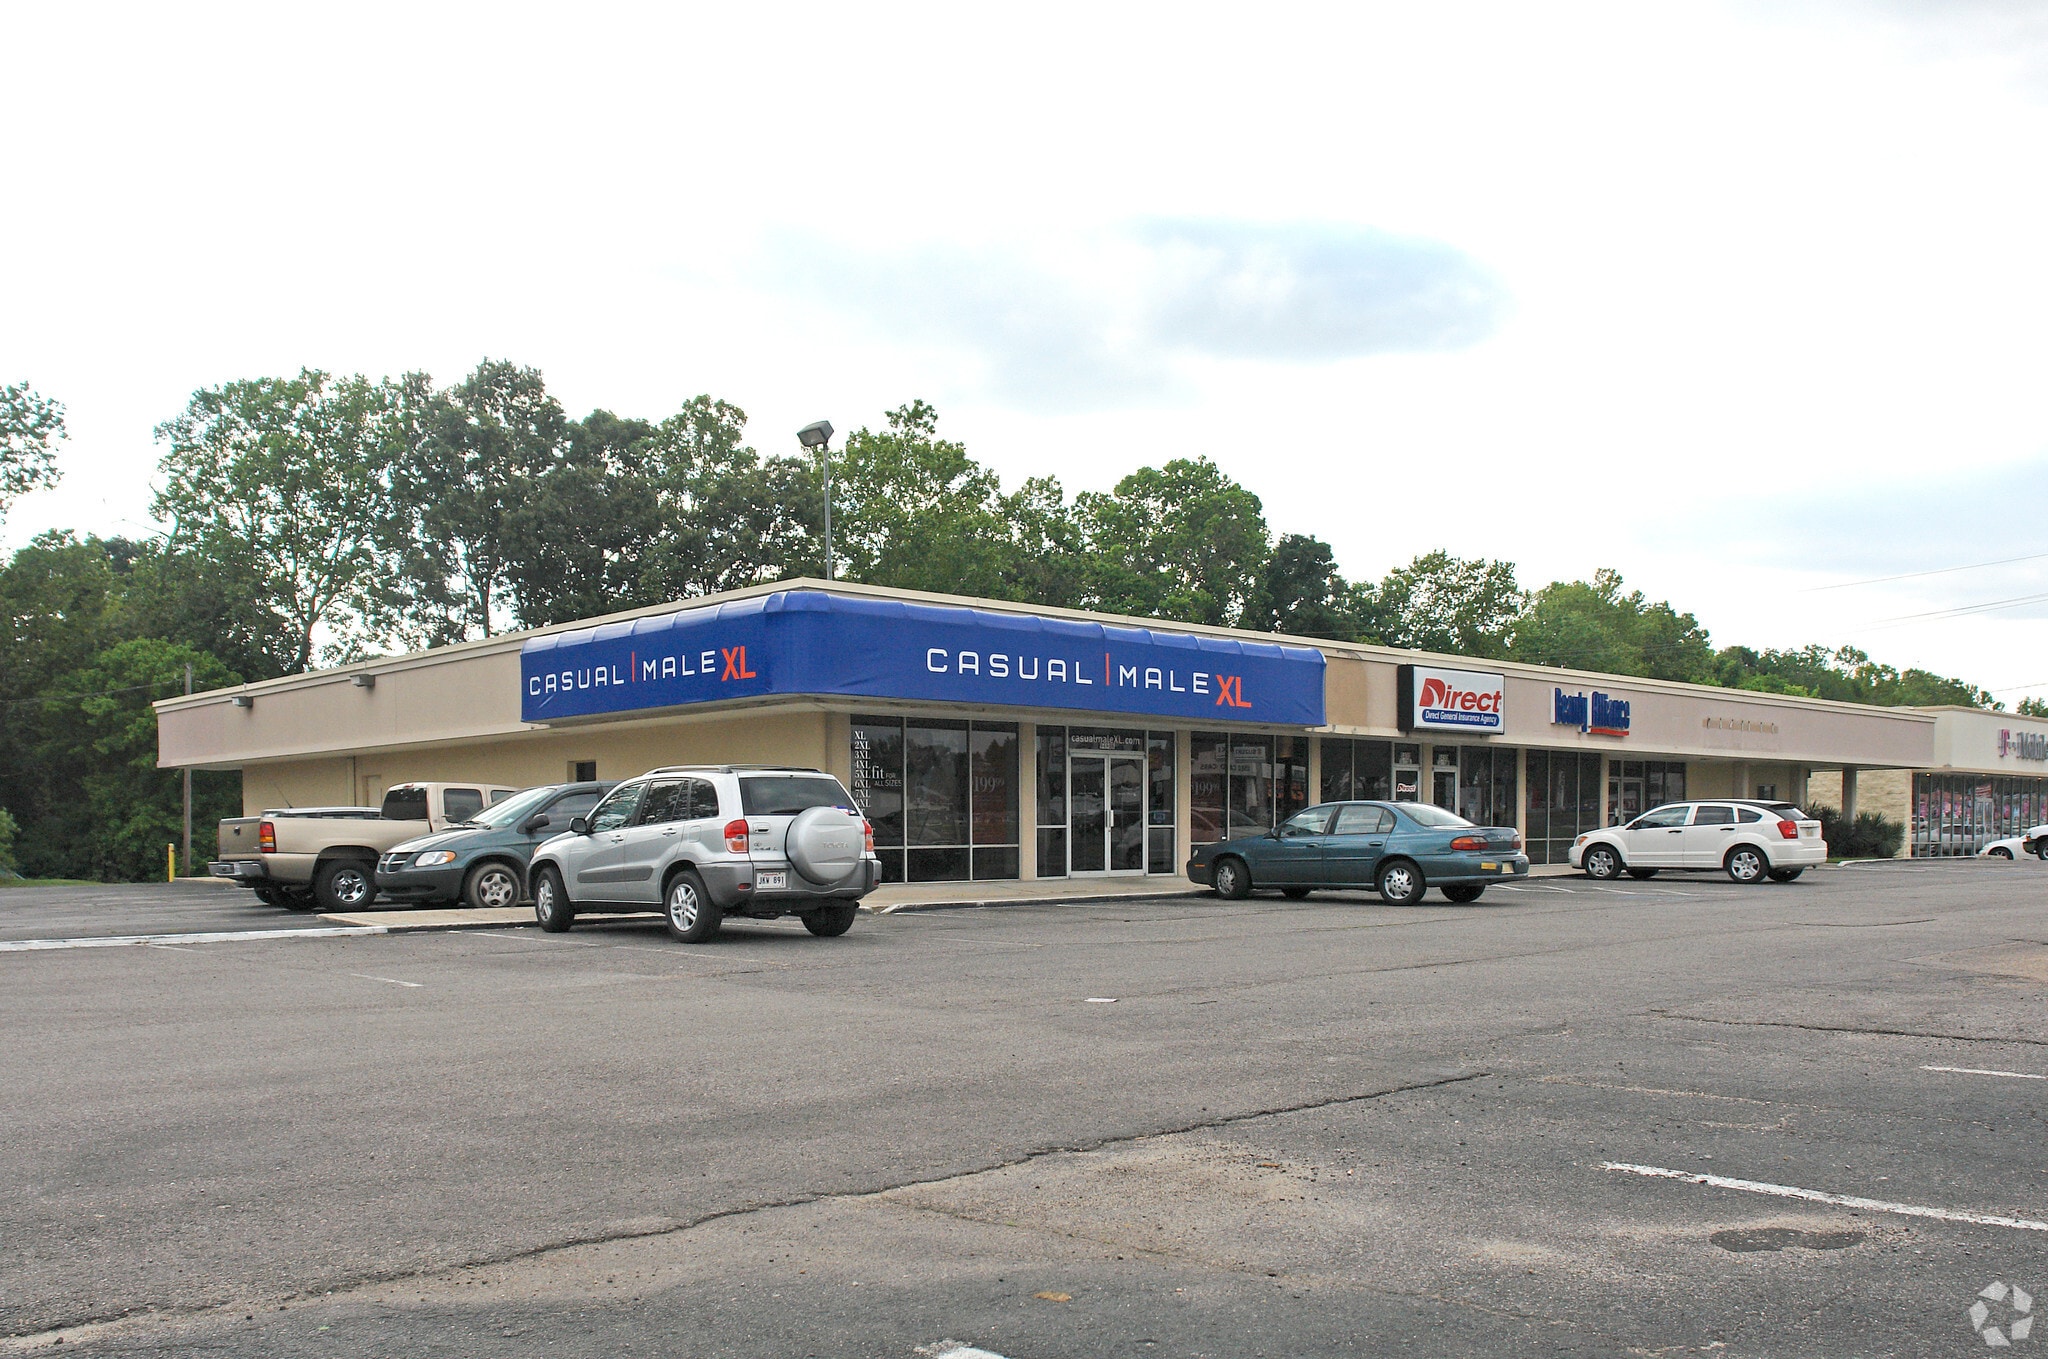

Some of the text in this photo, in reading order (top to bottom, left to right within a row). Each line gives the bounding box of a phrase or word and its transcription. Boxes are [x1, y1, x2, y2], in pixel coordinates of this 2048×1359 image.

[529, 646, 756, 696] CASUAL MALE XL
[926, 648, 1252, 708] CASUAL MALE XL
[1419, 678, 1502, 713] Direct
[1425, 710, 1497, 725] Direct General Insurance Agency
[854, 730, 866, 740] XL
[1071, 734, 1141, 745] casualmaleXL.com
[854, 740, 871, 750] 2XL
[854, 750, 871, 759] 3XL
[854, 760, 871, 769] 4XL
[854, 769, 871, 779] 5XL
[871, 765, 885, 779] fit
[854, 779, 871, 789] 6XL
[855, 789, 871, 798] 7XL
